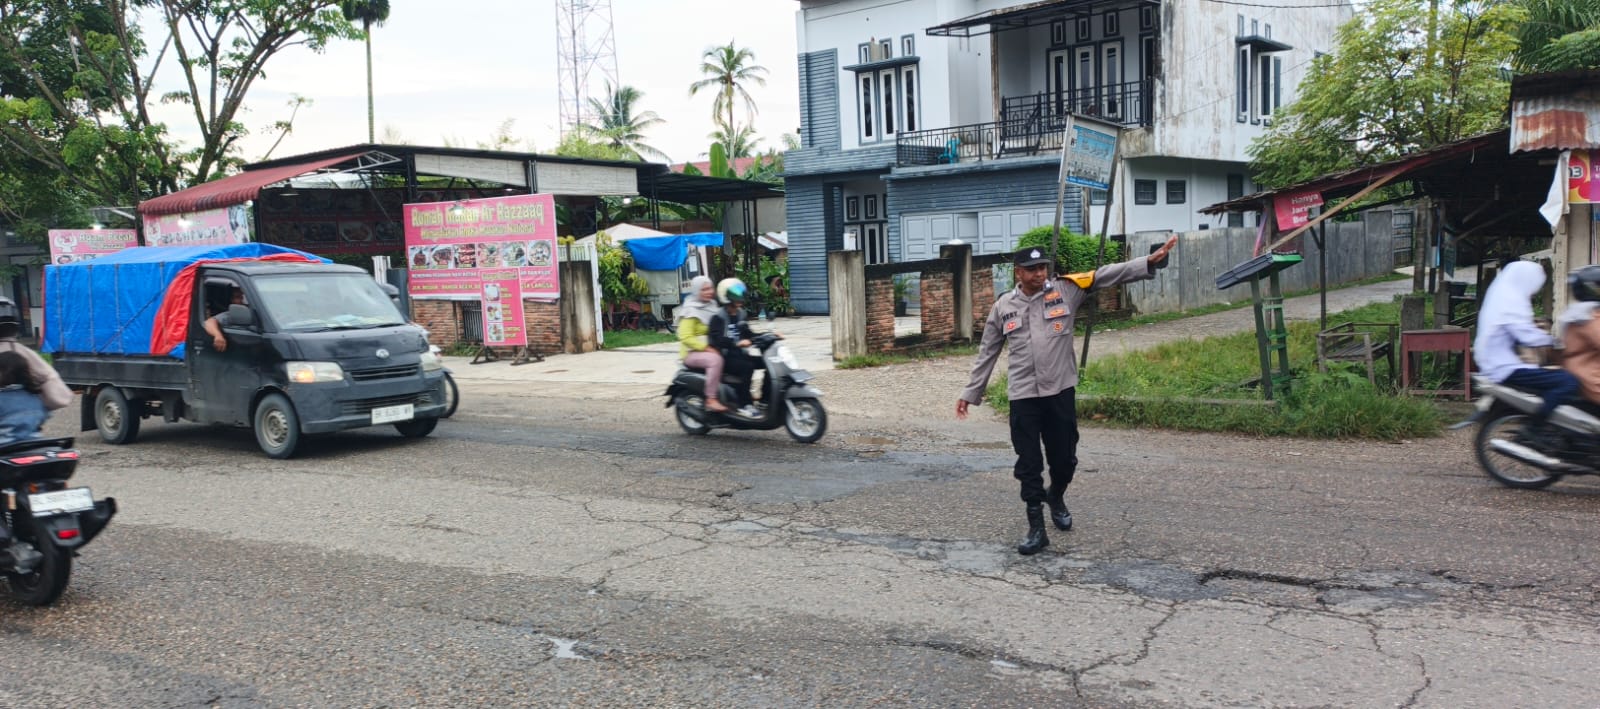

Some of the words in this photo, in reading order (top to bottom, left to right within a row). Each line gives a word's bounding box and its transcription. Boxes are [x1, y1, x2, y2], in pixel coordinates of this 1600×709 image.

[1292, 194, 1319, 204] Hanya
[411, 206, 443, 227] Rumah
[496, 202, 544, 226] Razzaaq
